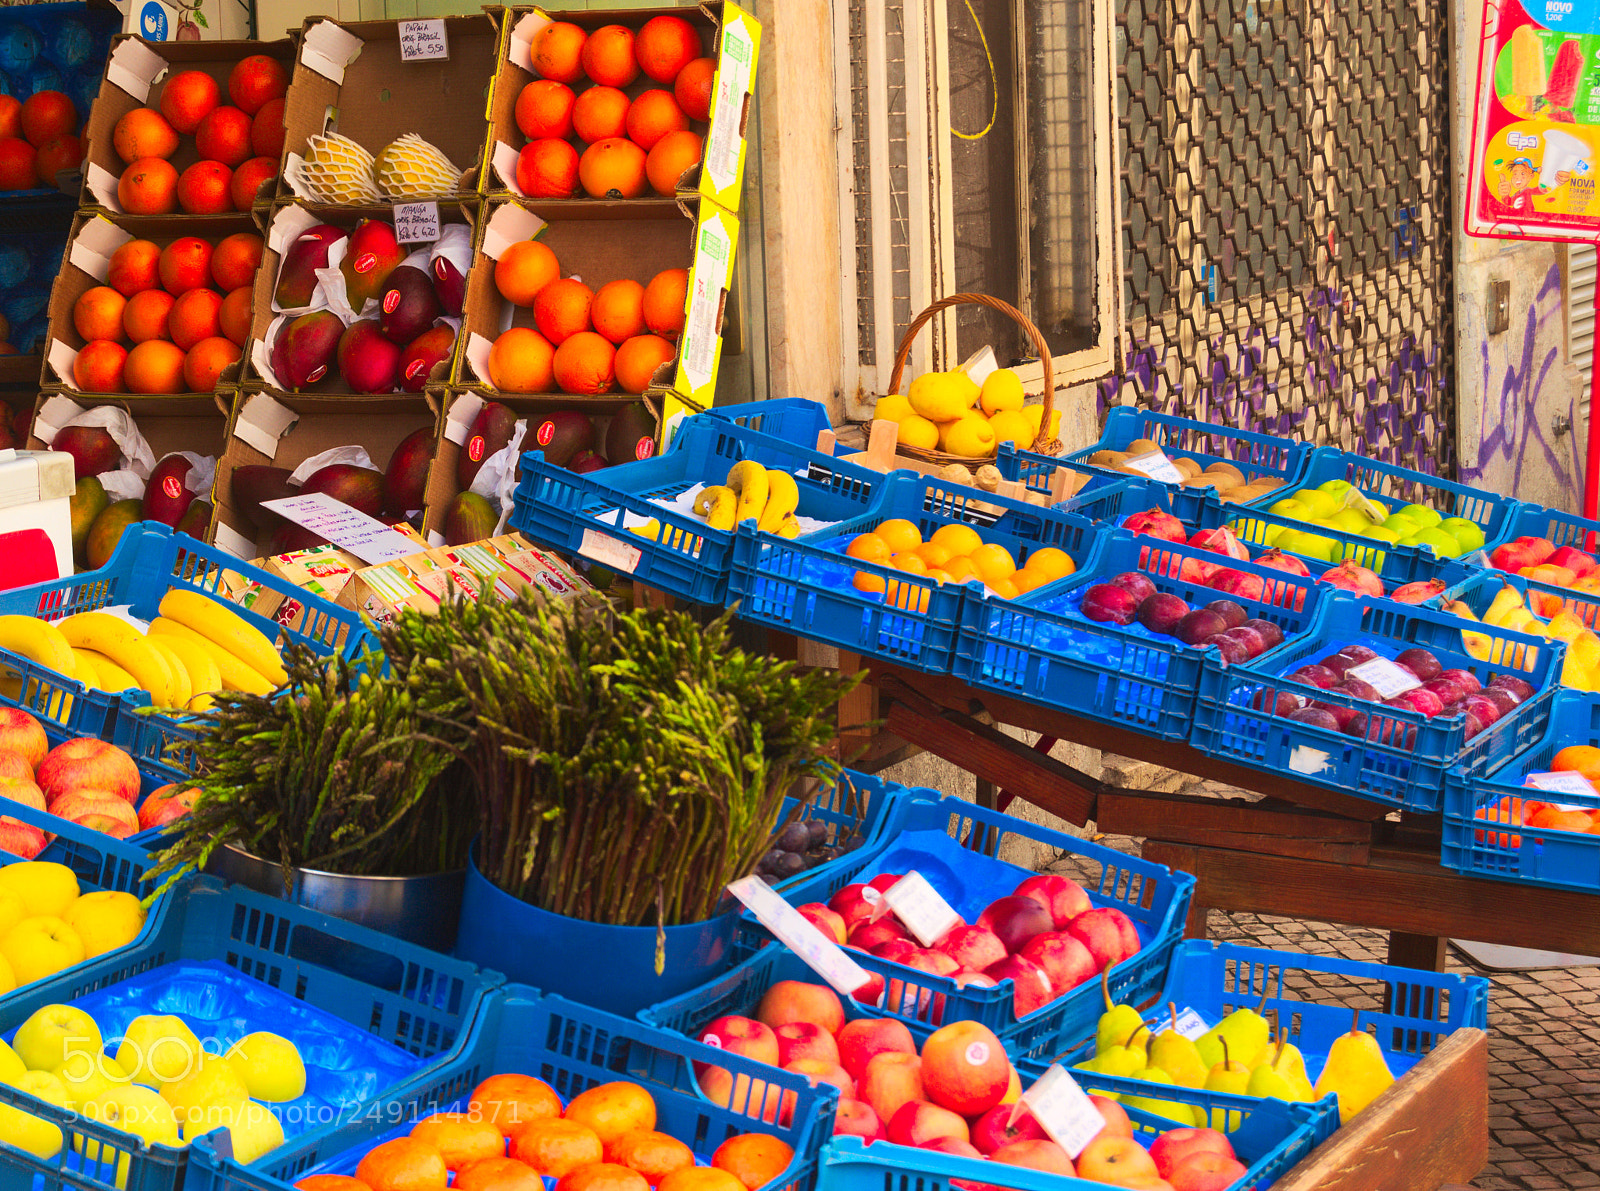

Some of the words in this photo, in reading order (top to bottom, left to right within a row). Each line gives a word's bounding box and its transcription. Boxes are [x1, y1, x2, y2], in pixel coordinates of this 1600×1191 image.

[1546, 1, 1572, 12] NOVO
[427, 43, 444, 54] 5,50
[1570, 177, 1595, 188] NOVA
[421, 226, 436, 237] 6,20
